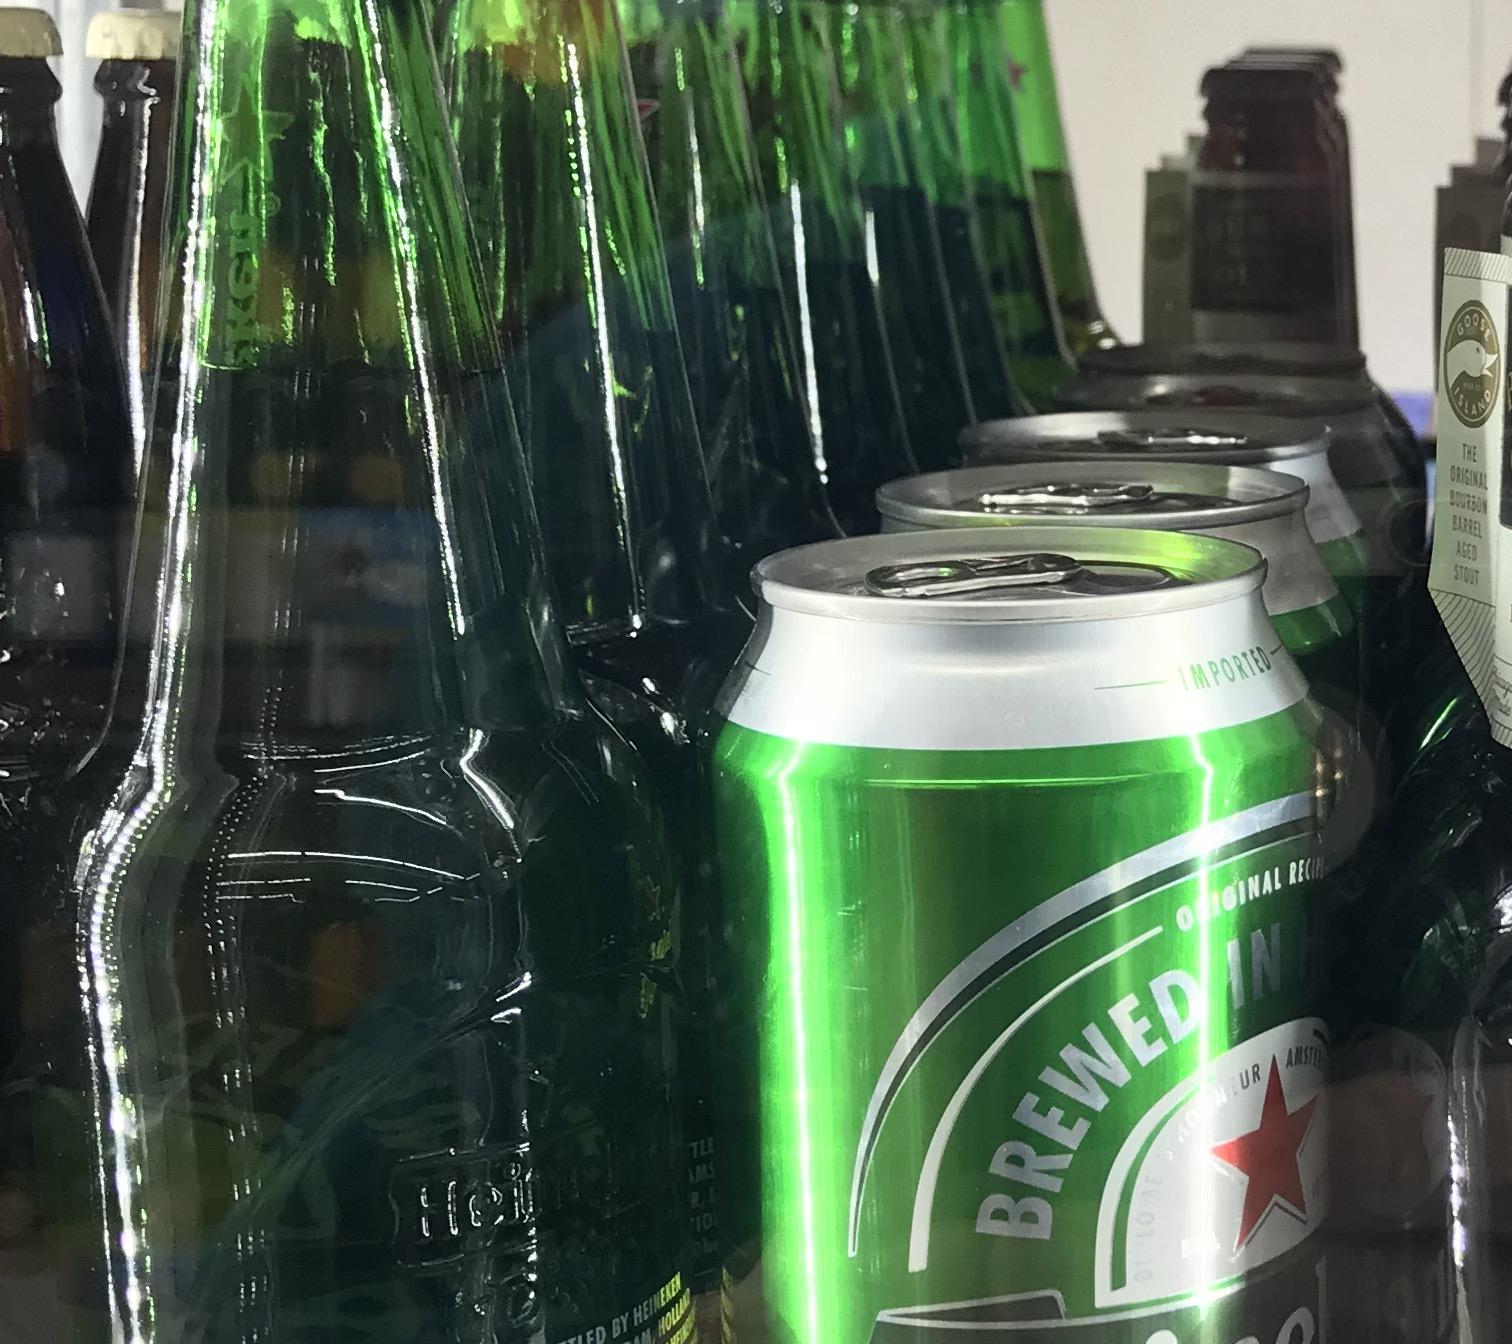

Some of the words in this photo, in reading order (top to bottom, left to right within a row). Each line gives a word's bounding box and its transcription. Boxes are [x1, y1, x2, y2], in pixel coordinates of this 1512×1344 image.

[1457, 313, 1491, 342] GOOSE
[1453, 387, 1492, 416] ISLAND
[1462, 442, 1478, 464] THE
[1449, 464, 1489, 491] ORIGINAL
[1452, 513, 1483, 540] BARREL
[1456, 539, 1478, 563] AGED
[1454, 563, 1480, 587] STOUT
[1177, 645, 1272, 692] IMPORTED
[976, 969, 1205, 1240] BREWED
[1226, 922, 1281, 1010] IN
